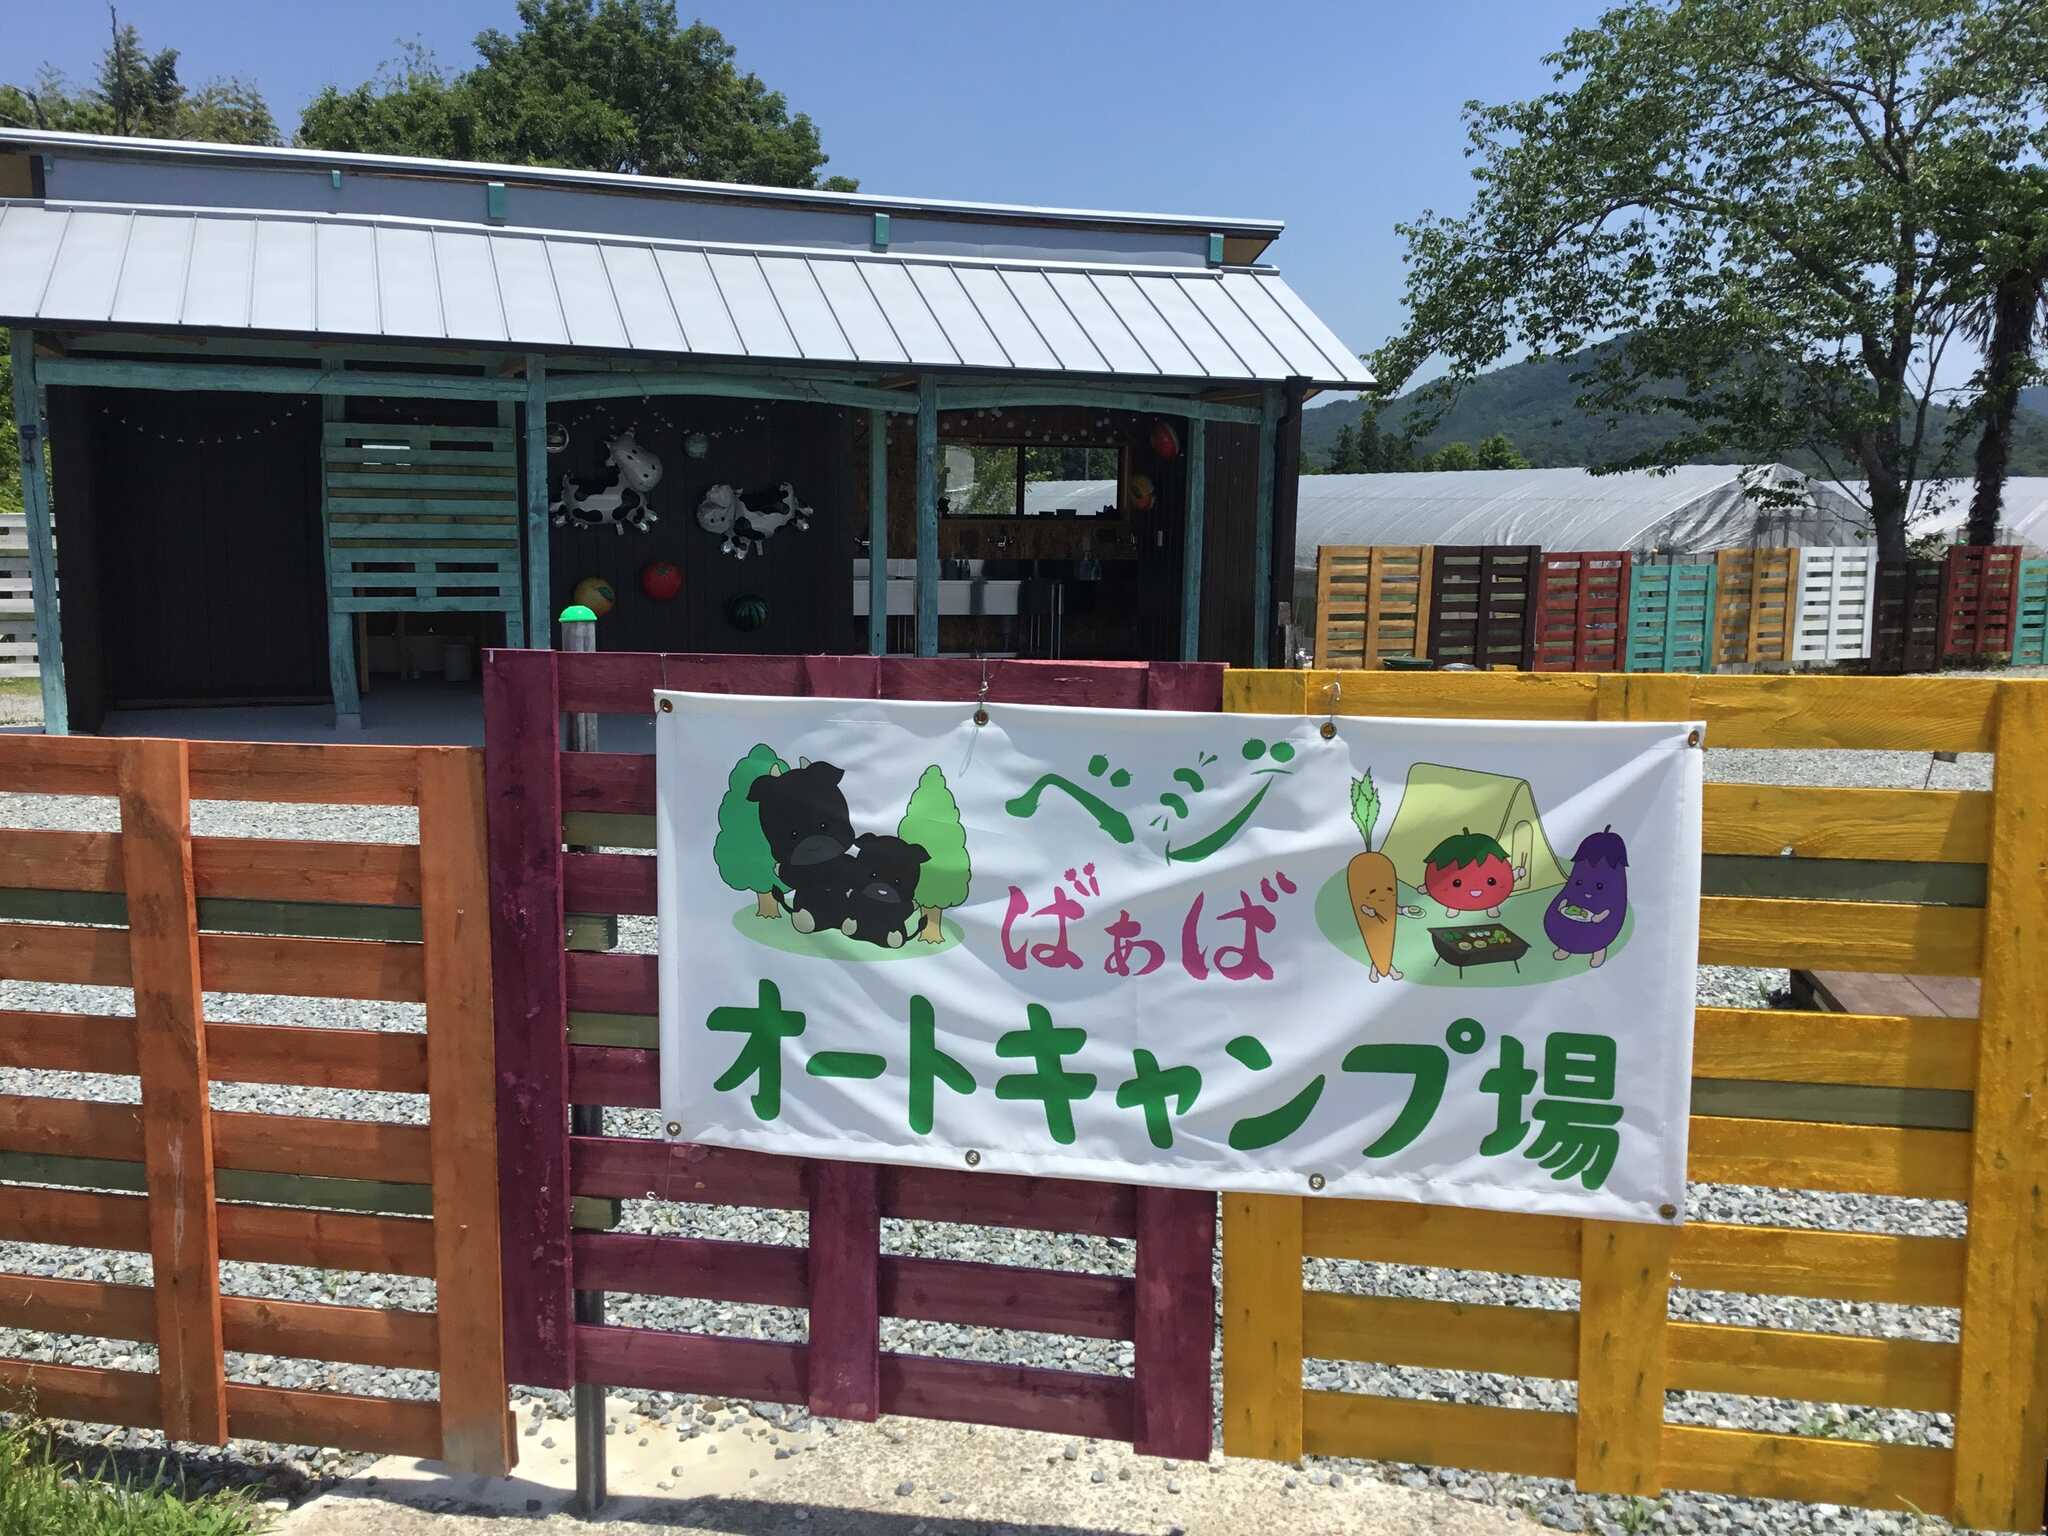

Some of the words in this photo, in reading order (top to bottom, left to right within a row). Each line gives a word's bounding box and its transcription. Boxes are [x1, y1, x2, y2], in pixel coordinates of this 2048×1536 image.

[1005, 739, 1295, 863] ベジ
[1001, 863, 1297, 981] ばぁば
[706, 978, 1624, 1190] オートキャンプ場
